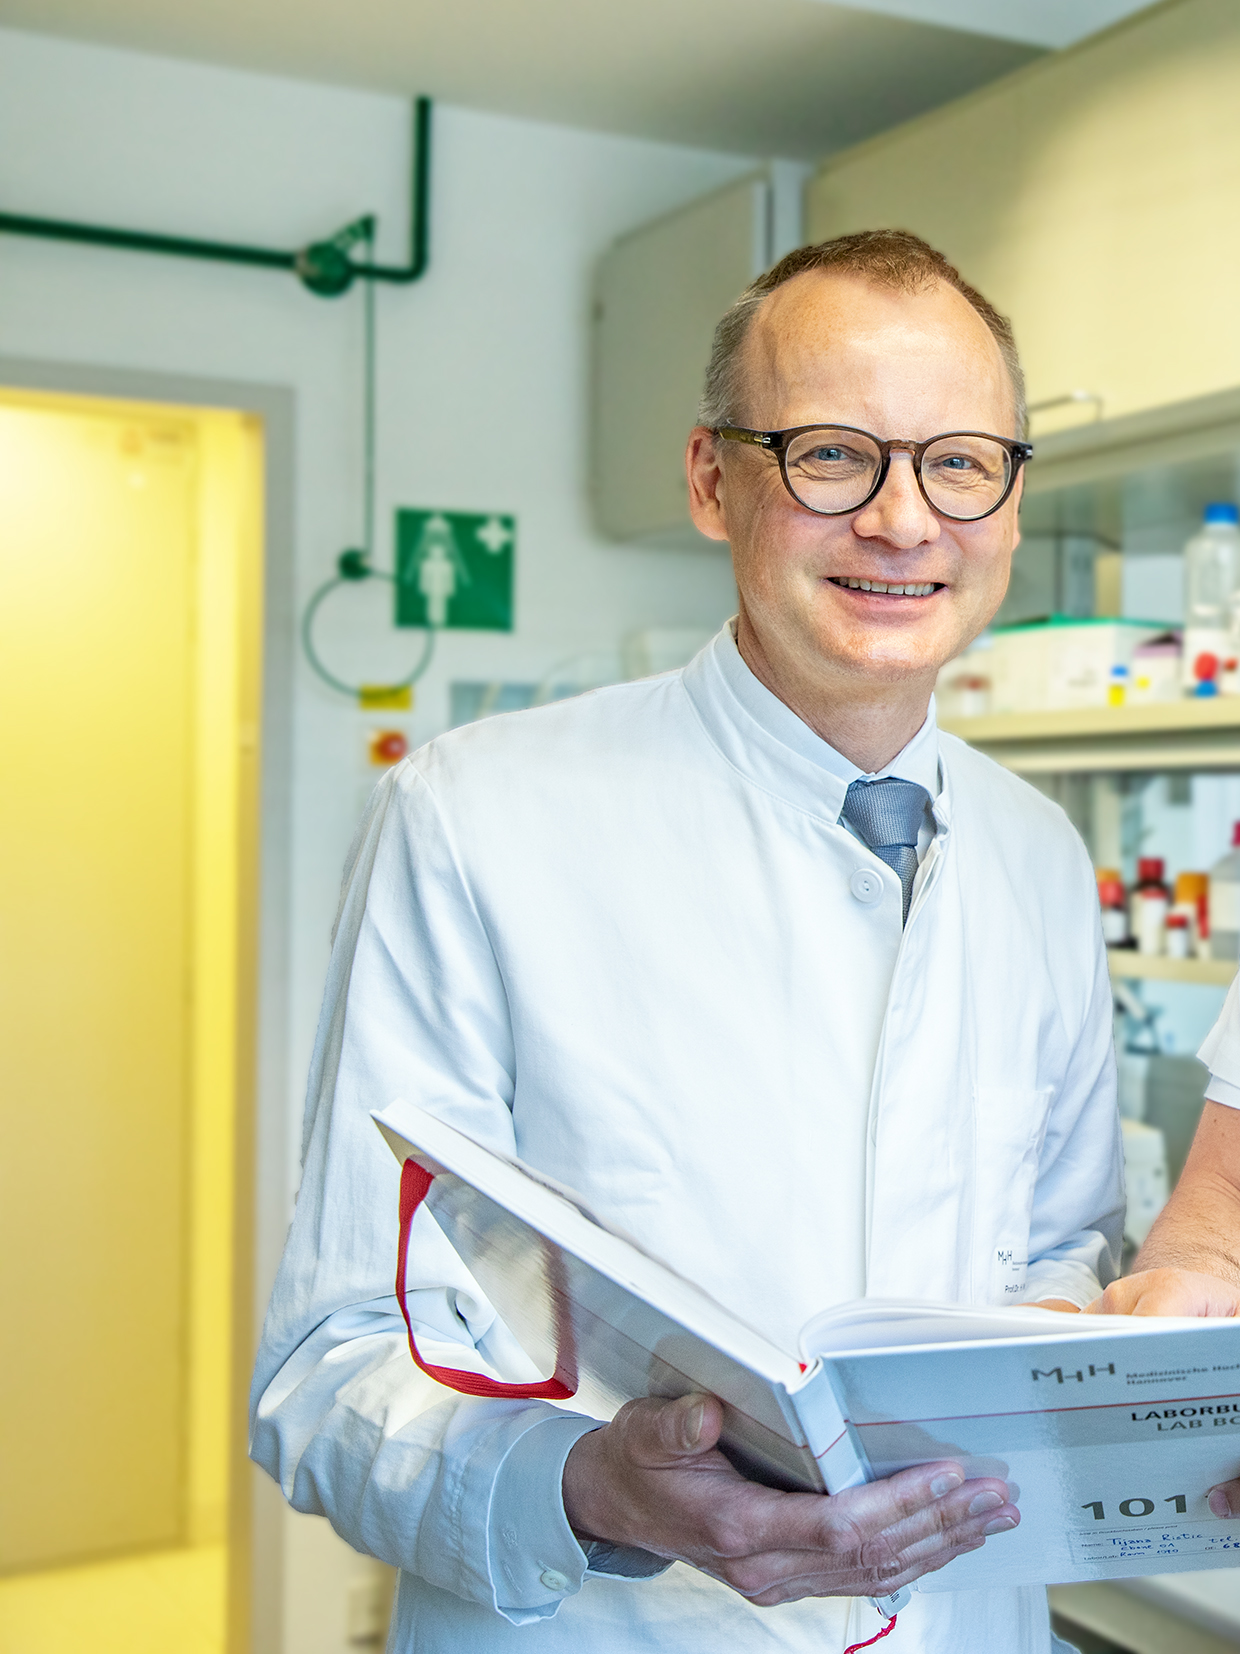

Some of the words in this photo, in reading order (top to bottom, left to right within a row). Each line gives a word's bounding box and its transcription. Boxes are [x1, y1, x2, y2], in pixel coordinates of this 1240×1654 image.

[1031, 1362, 1115, 1384] MHH
[1156, 1418, 1203, 1431] LAB
[1081, 1493, 1209, 1520] 101
